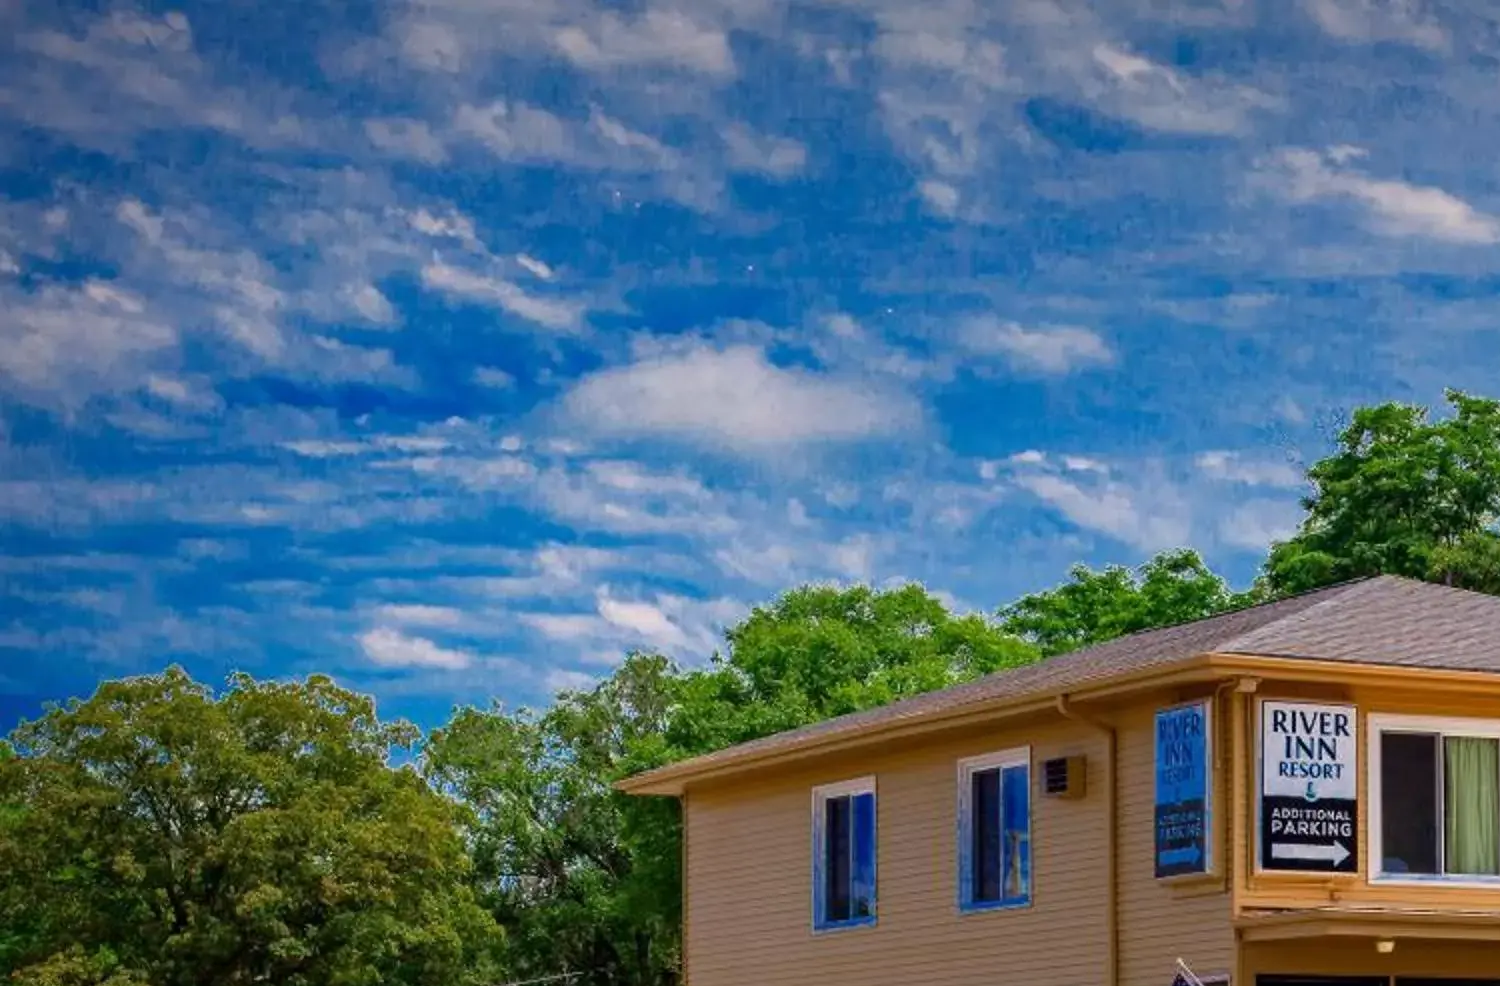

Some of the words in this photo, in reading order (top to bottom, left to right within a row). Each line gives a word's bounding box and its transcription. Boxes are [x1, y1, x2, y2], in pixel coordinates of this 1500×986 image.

[1158, 713, 1201, 741] RIVER
[1272, 710, 1350, 737] RIVER
[1164, 741, 1193, 767] INN
[1285, 736, 1337, 761] INN
[1279, 761, 1345, 780] RESORT
[1272, 807, 1352, 821] ADDITIONAL
[1271, 820, 1352, 837] PARKING
